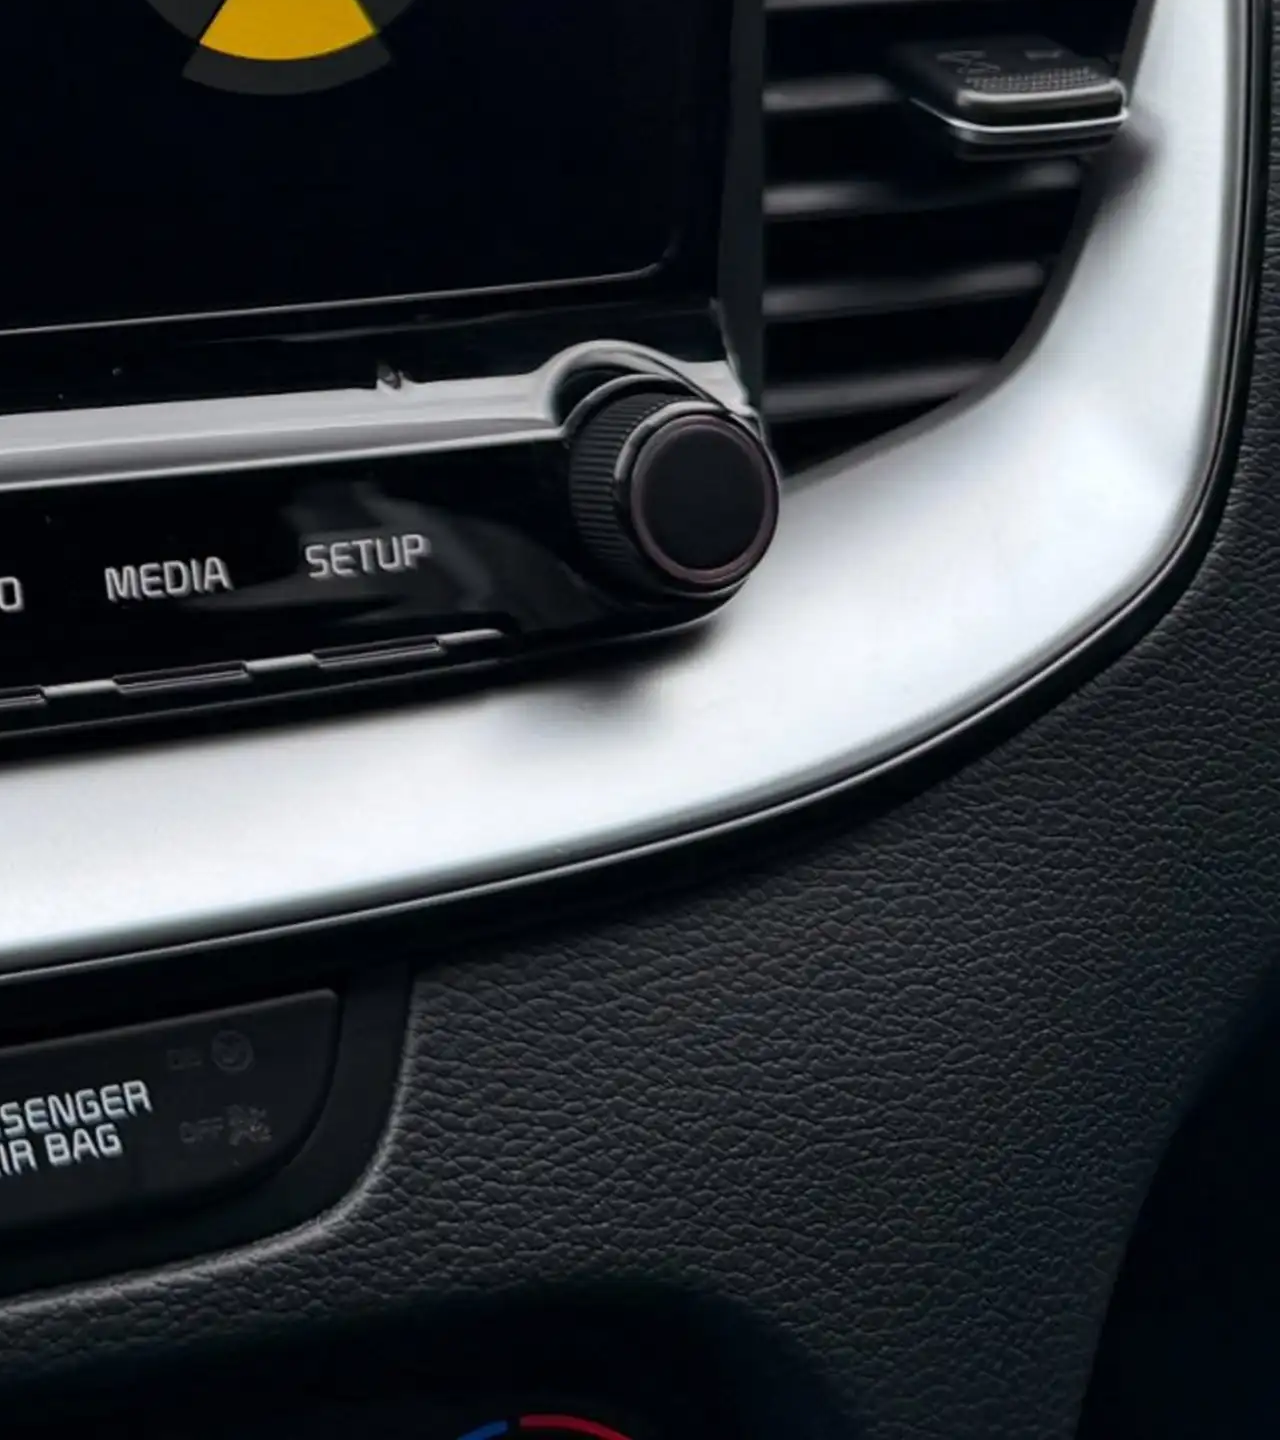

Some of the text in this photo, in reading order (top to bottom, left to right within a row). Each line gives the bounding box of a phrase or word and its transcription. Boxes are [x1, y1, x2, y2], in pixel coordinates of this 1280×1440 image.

[305, 533, 429, 578] SETUP
[104, 556, 229, 601] MEDIA
[44, 1123, 123, 1167] BAG
